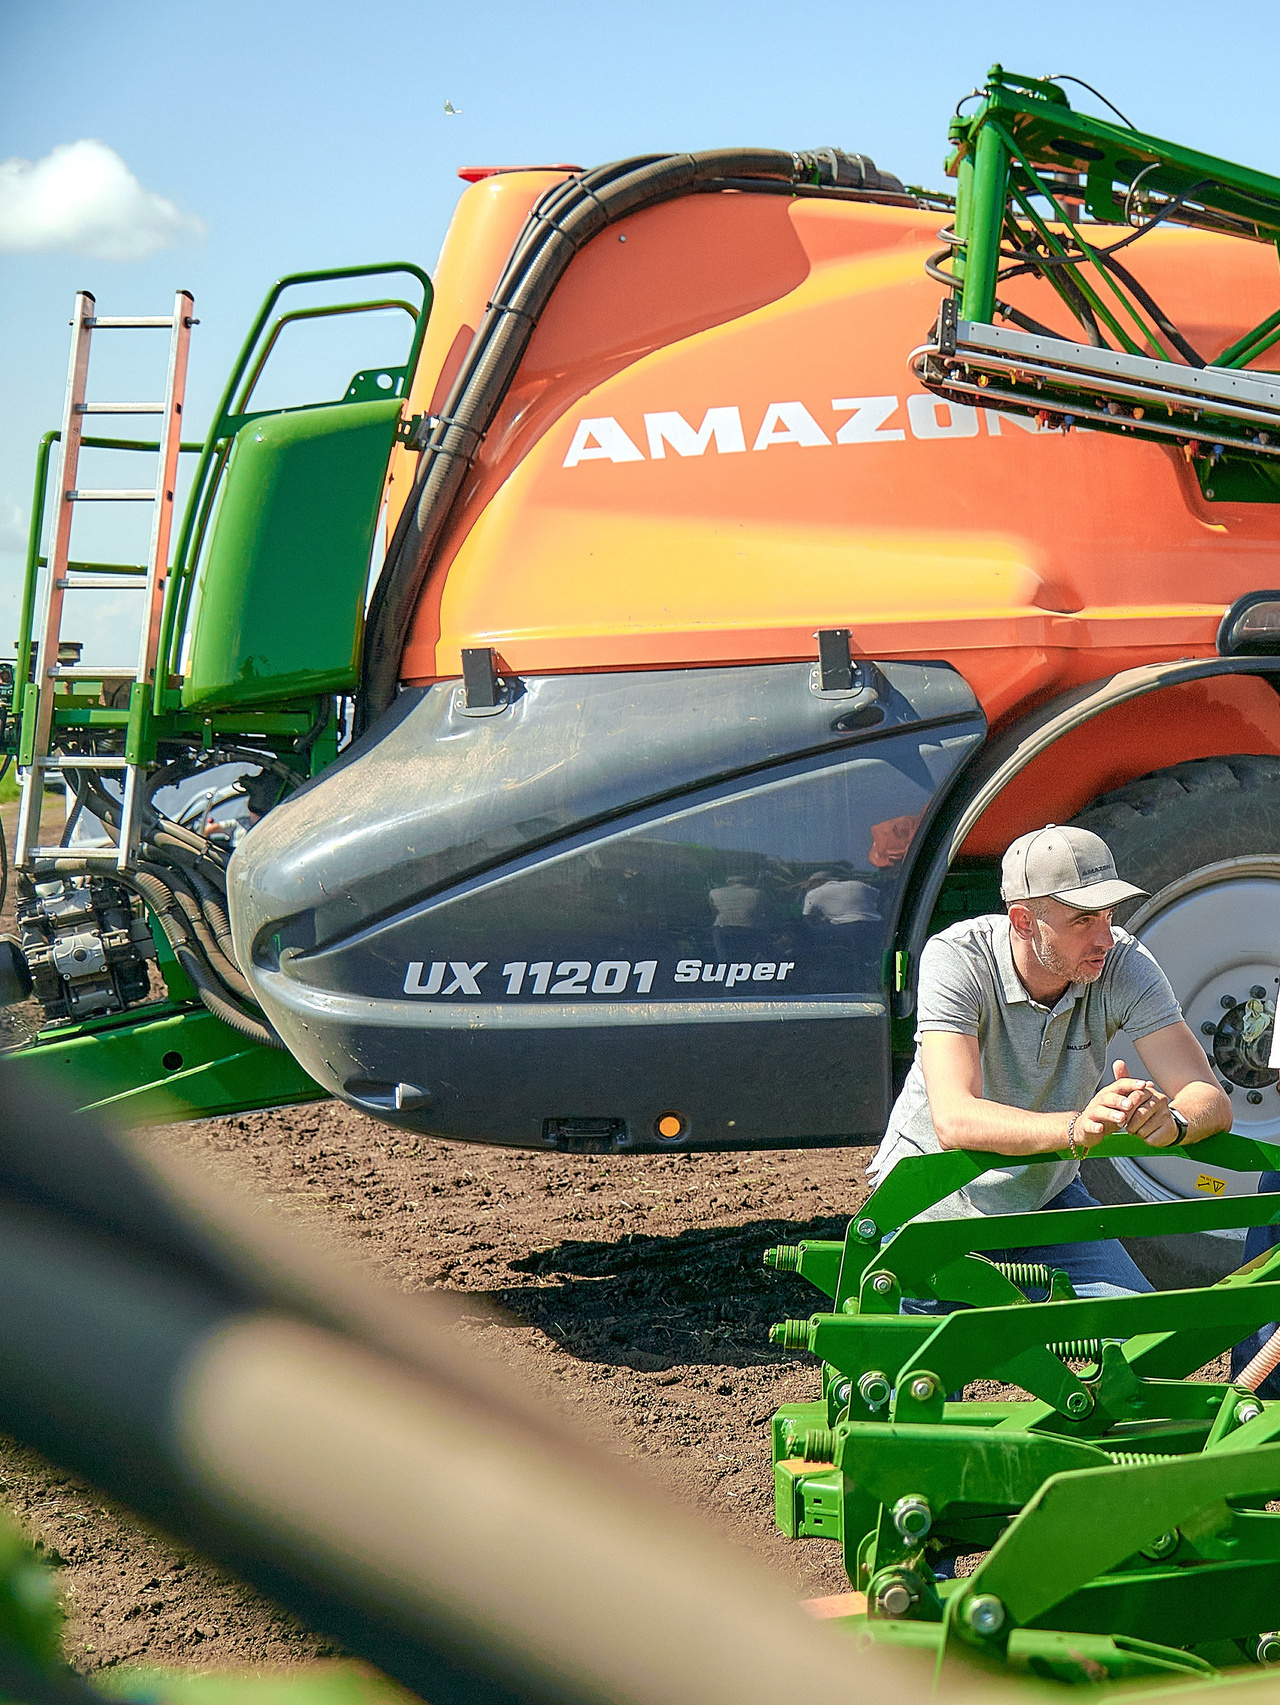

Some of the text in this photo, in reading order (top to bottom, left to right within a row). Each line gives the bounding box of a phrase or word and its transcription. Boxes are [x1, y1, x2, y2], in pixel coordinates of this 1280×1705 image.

[403, 959, 795, 995] UX 11201 Super
